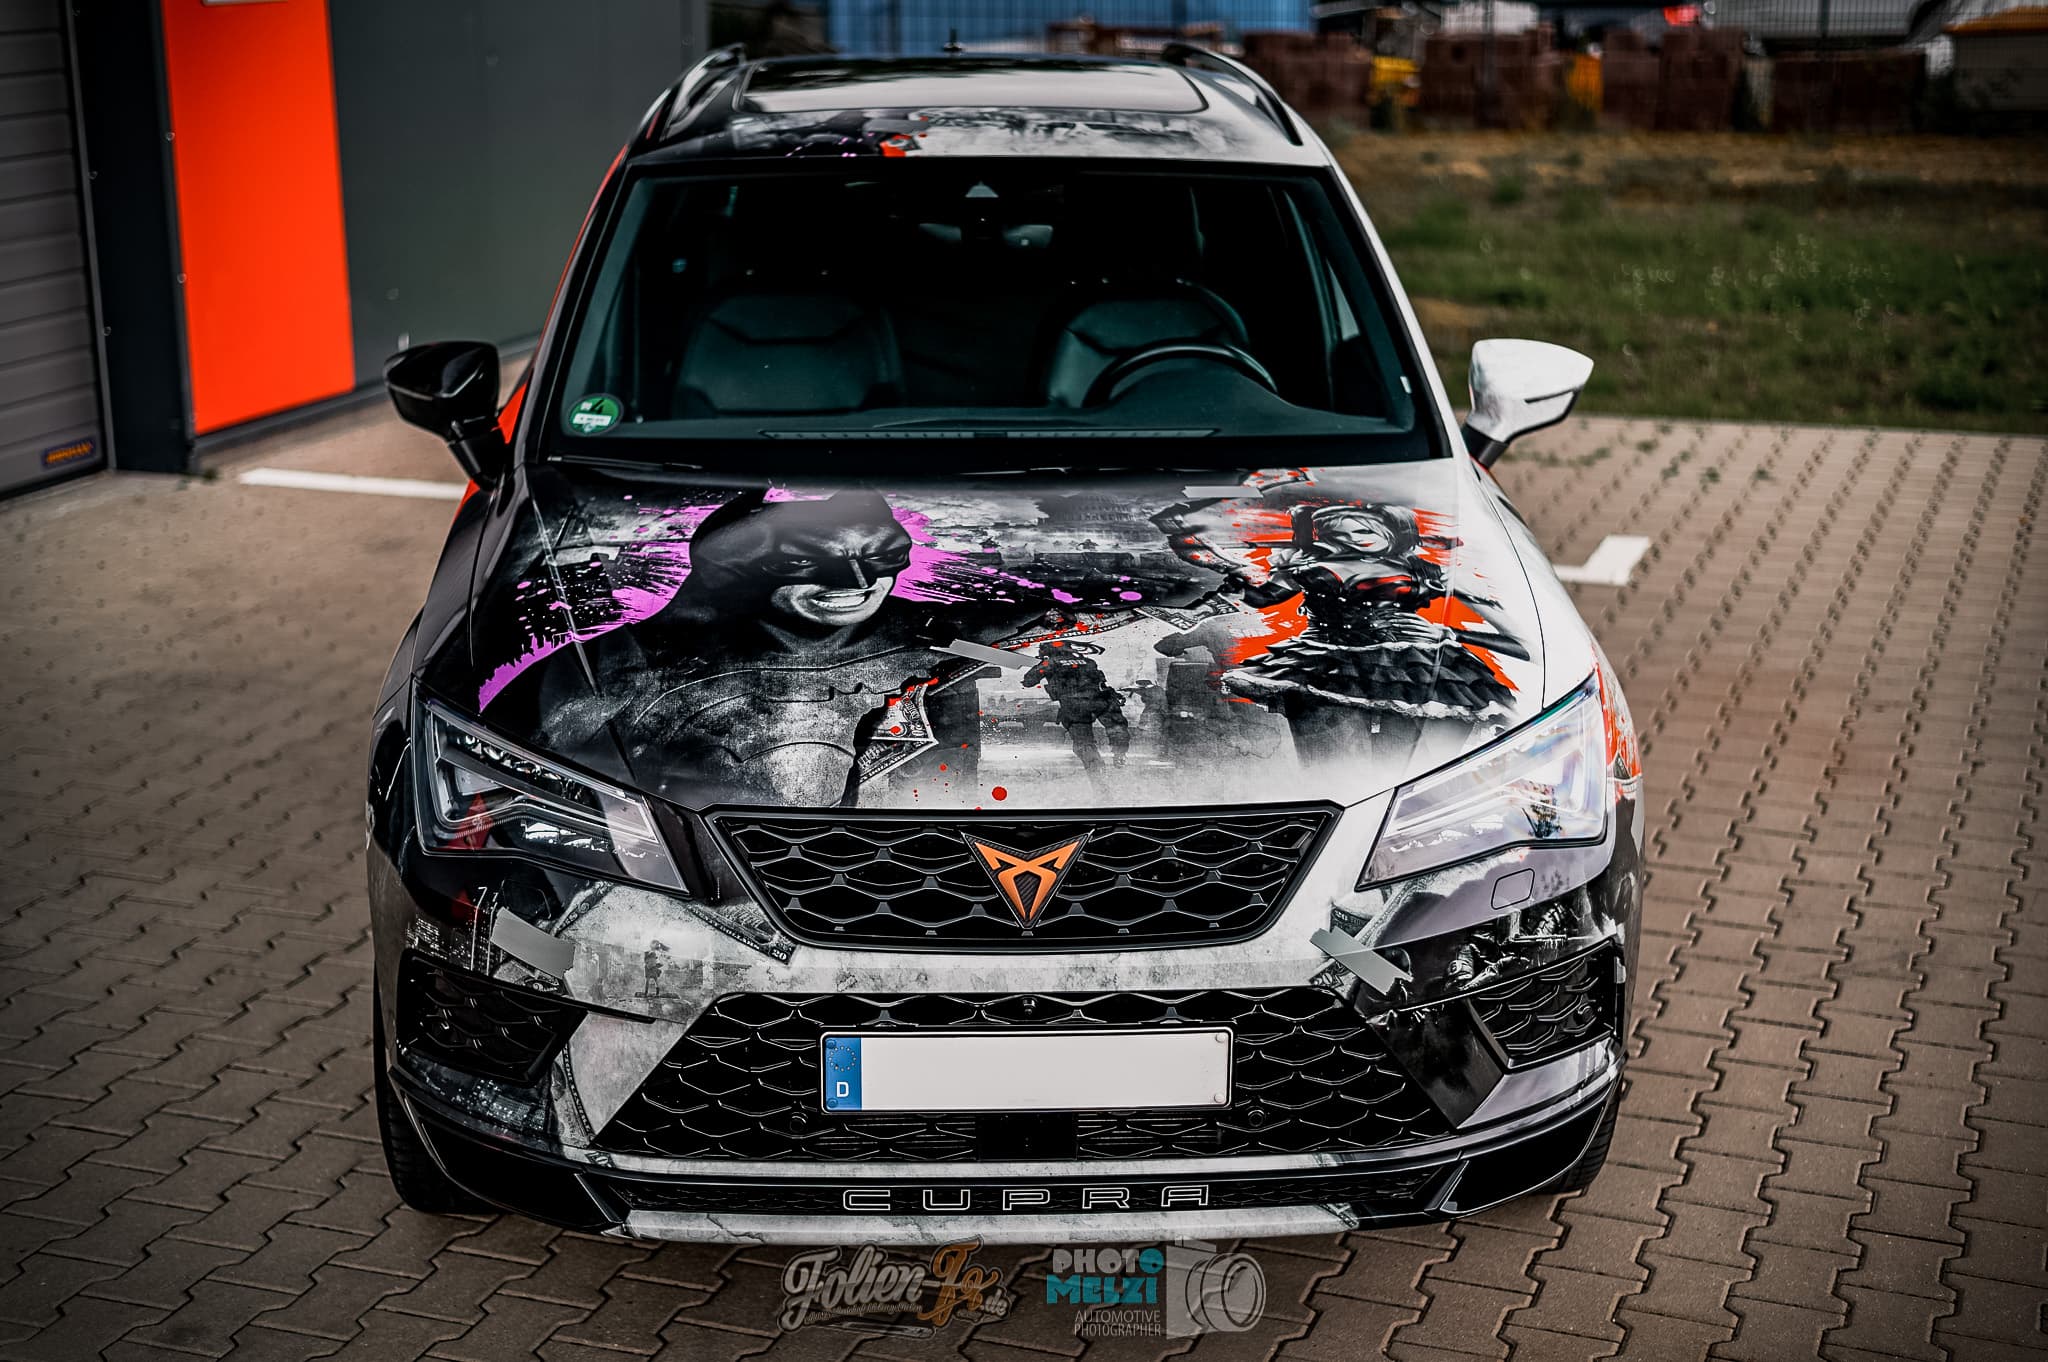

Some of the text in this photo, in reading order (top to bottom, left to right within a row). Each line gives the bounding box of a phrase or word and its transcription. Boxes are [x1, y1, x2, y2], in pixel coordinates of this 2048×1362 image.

[771, 948, 788, 961] 20
[836, 1081, 850, 1098] D
[843, 1185, 1209, 1211] CUPRA
